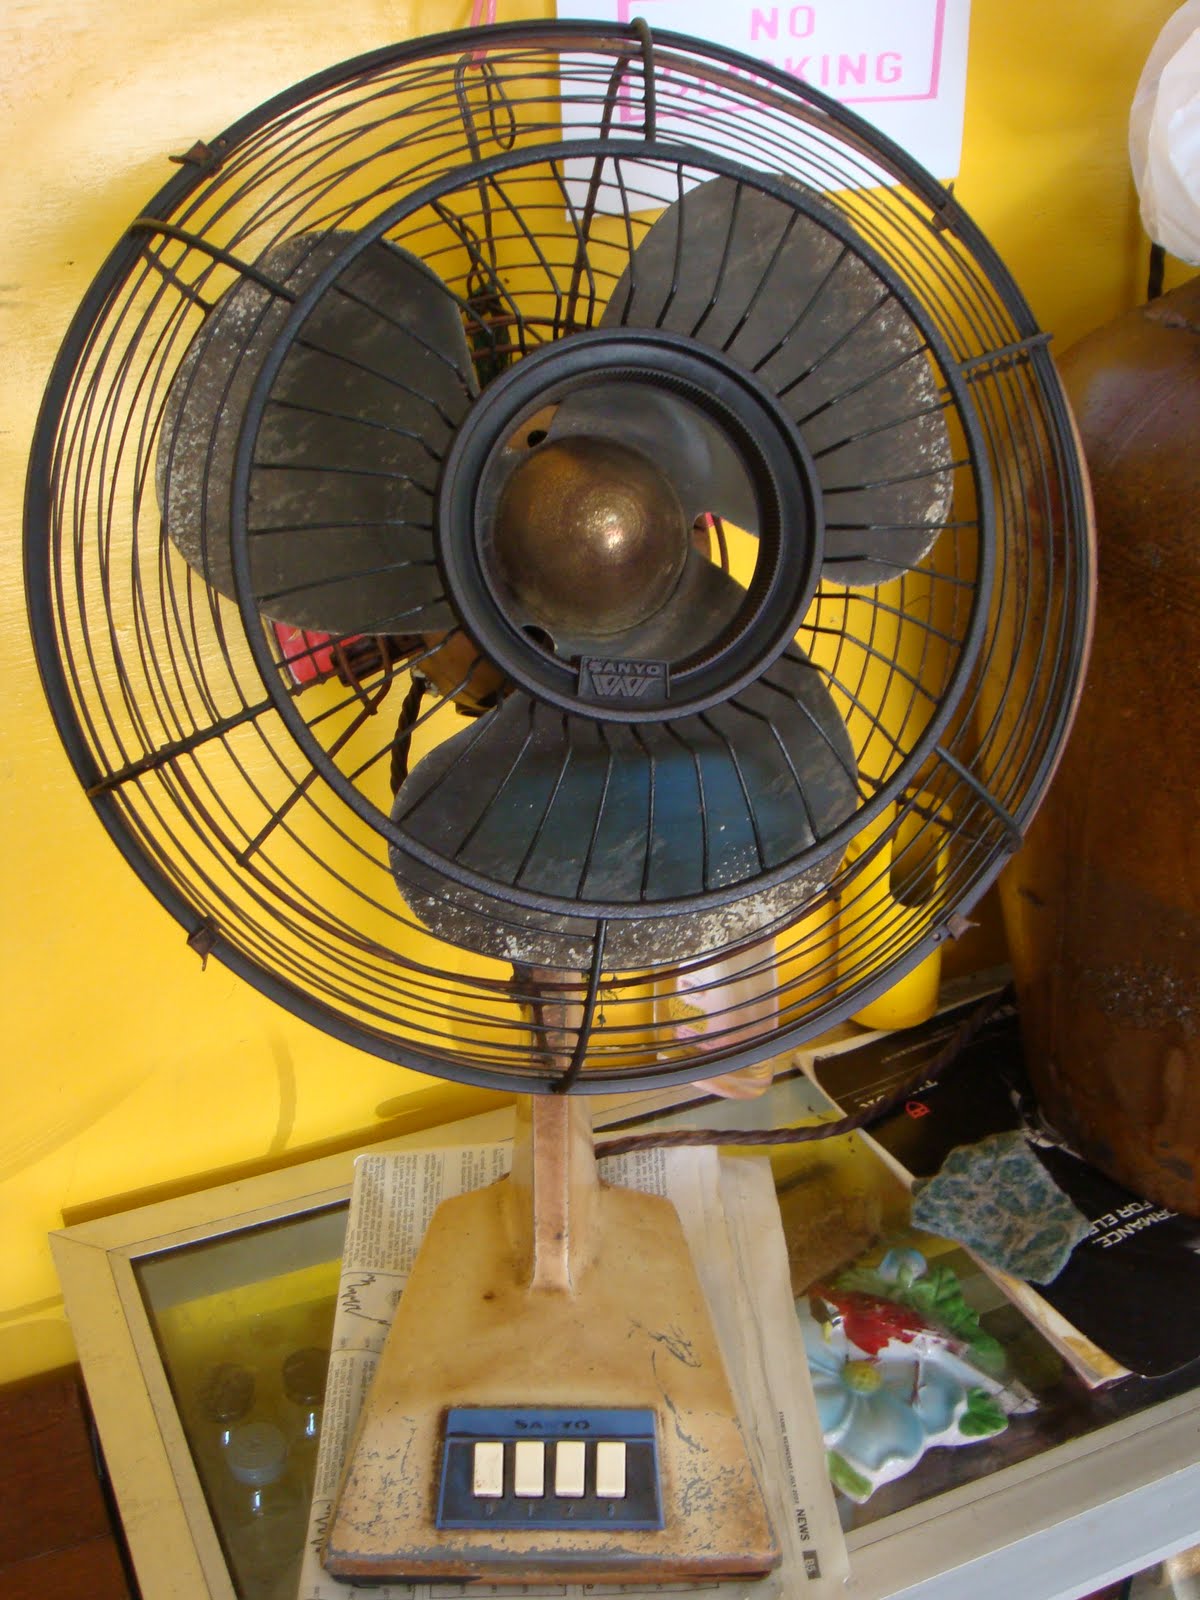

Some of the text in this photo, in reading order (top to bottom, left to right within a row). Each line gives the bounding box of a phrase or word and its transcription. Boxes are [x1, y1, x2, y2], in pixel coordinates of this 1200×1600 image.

[750, 5, 816, 41] NO
[588, 660, 661, 675] SANYO
[1116, 1200, 1153, 1218] FOR
[514, 1419, 591, 1431] SAYO
[796, 1508, 810, 1541] NEWS
